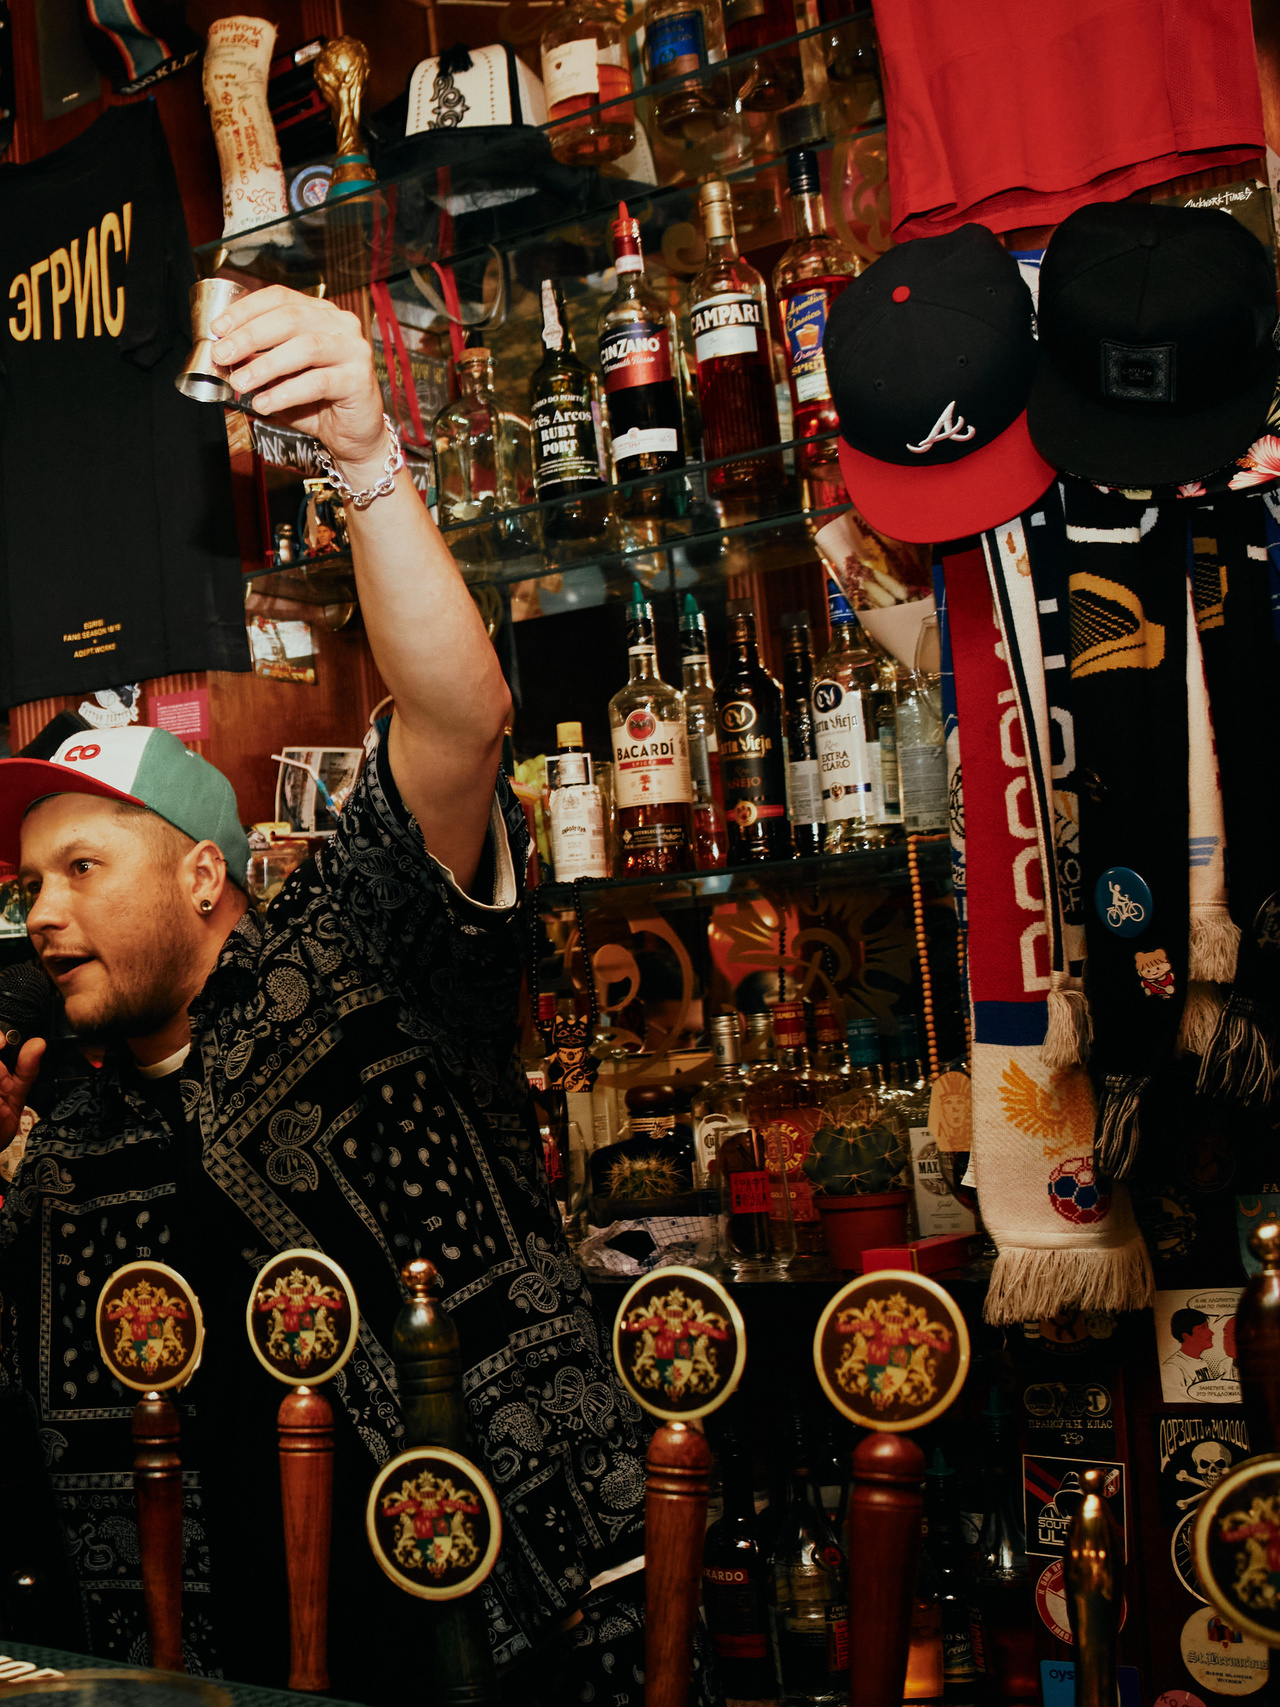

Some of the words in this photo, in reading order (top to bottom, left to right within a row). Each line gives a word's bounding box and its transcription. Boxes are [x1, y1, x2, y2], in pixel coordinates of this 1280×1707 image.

[692, 303, 760, 334] CAMPARI
[601, 337, 660, 365] CINZANO
[553, 410, 592, 424] Arcos
[541, 424, 577, 442] RUBY
[543, 439, 578, 457] PORT
[617, 738, 675, 761] BACARDÍ
[822, 750, 849, 765] EXTRA
[1086, 1419, 1113, 1430] КЛАС
